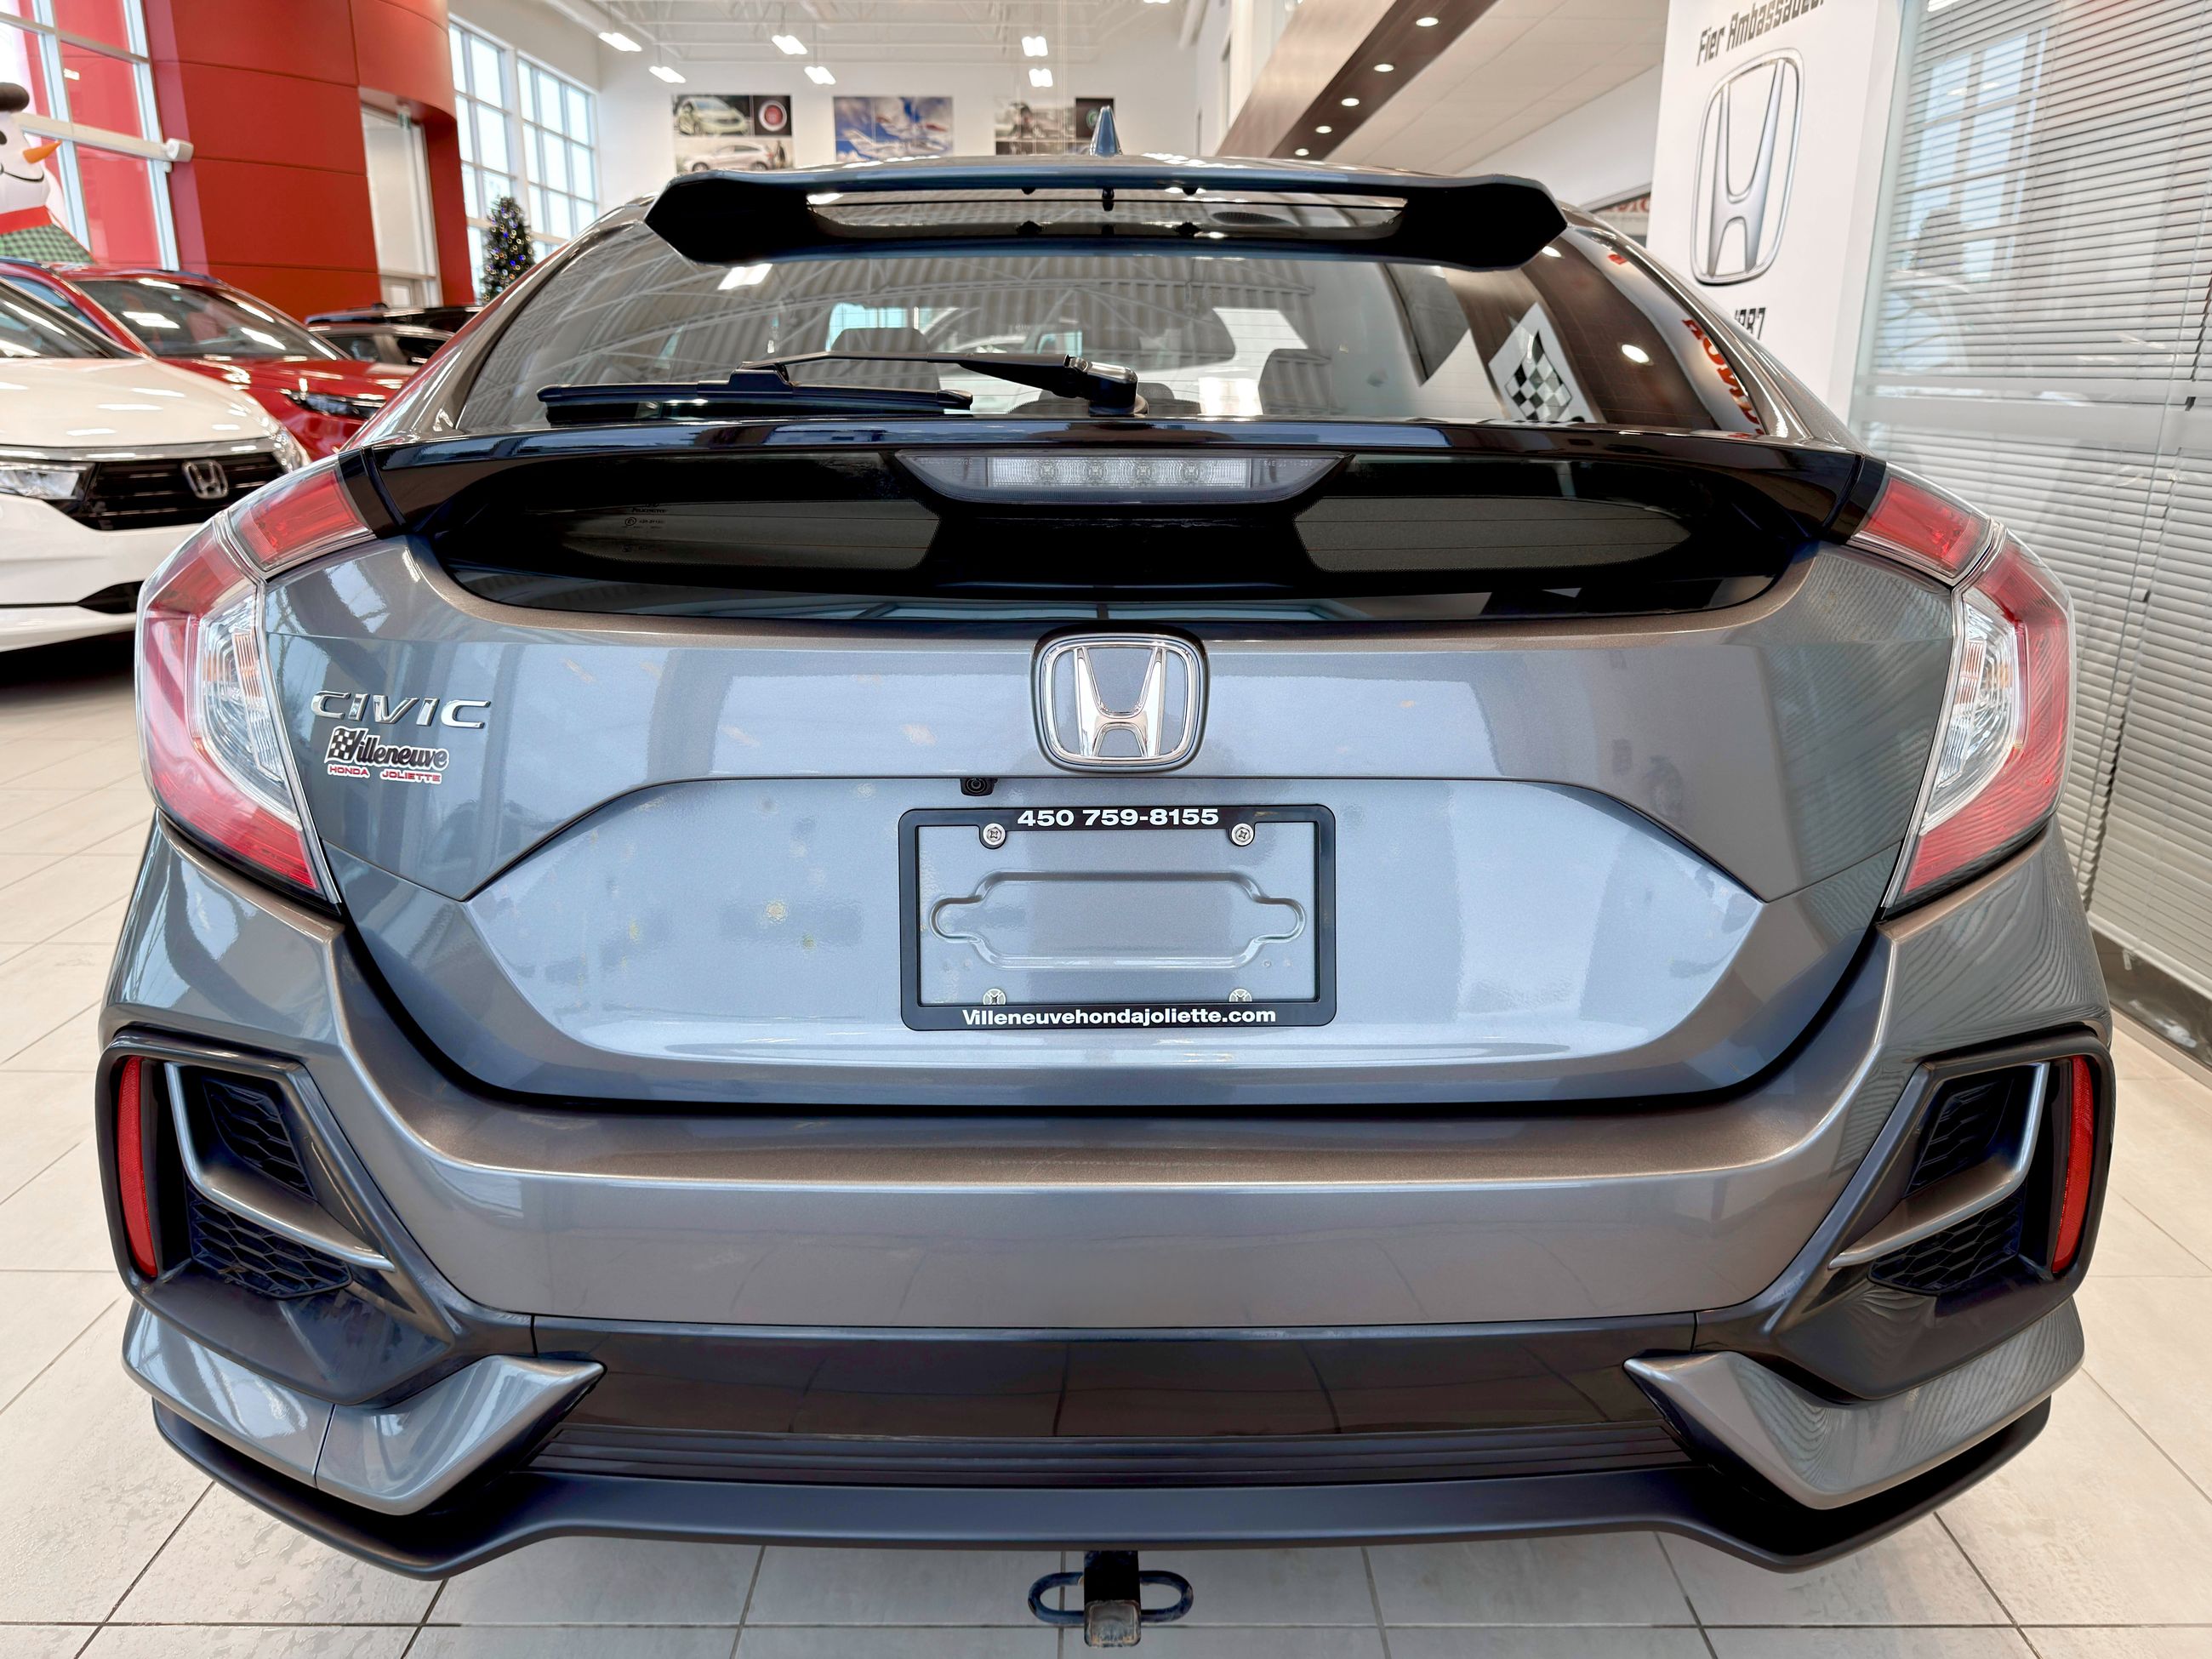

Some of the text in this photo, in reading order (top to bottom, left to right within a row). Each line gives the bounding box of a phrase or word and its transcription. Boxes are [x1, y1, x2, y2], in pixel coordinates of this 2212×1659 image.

[1697, 26, 1725, 66] Fier
[311, 690, 492, 729] CIVIC
[327, 727, 448, 767] Villeneuve
[329, 765, 442, 783] HONDA JOLIETTE
[1017, 808, 1219, 827] 450 759-8155
[961, 1008, 1277, 1028] Villeneuvehondajoliette.com
